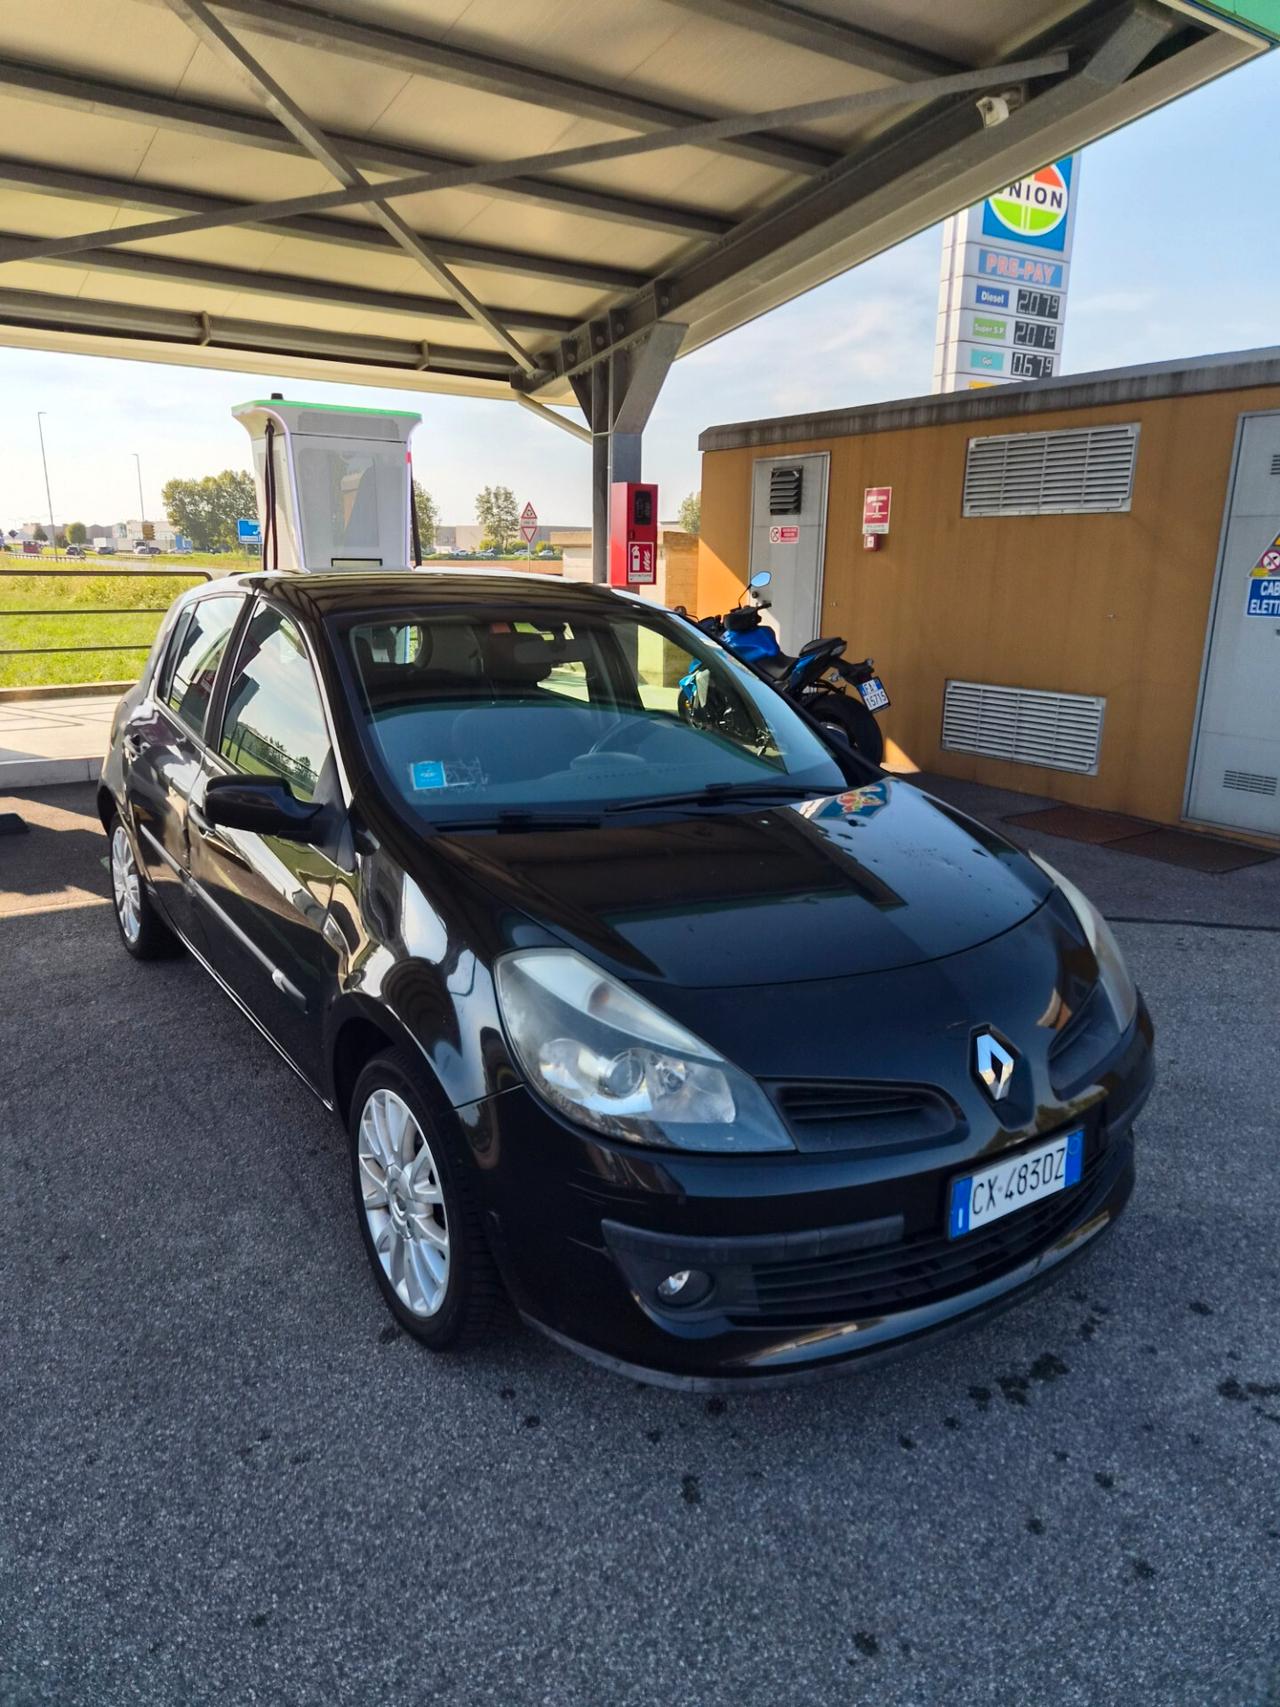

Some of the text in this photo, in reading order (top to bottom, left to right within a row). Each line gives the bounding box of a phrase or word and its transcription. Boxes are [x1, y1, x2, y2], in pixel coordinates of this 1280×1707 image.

[999, 181, 1063, 209] NION
[985, 253, 1055, 283] PRE-PAY
[981, 290, 1005, 304] Diesel
